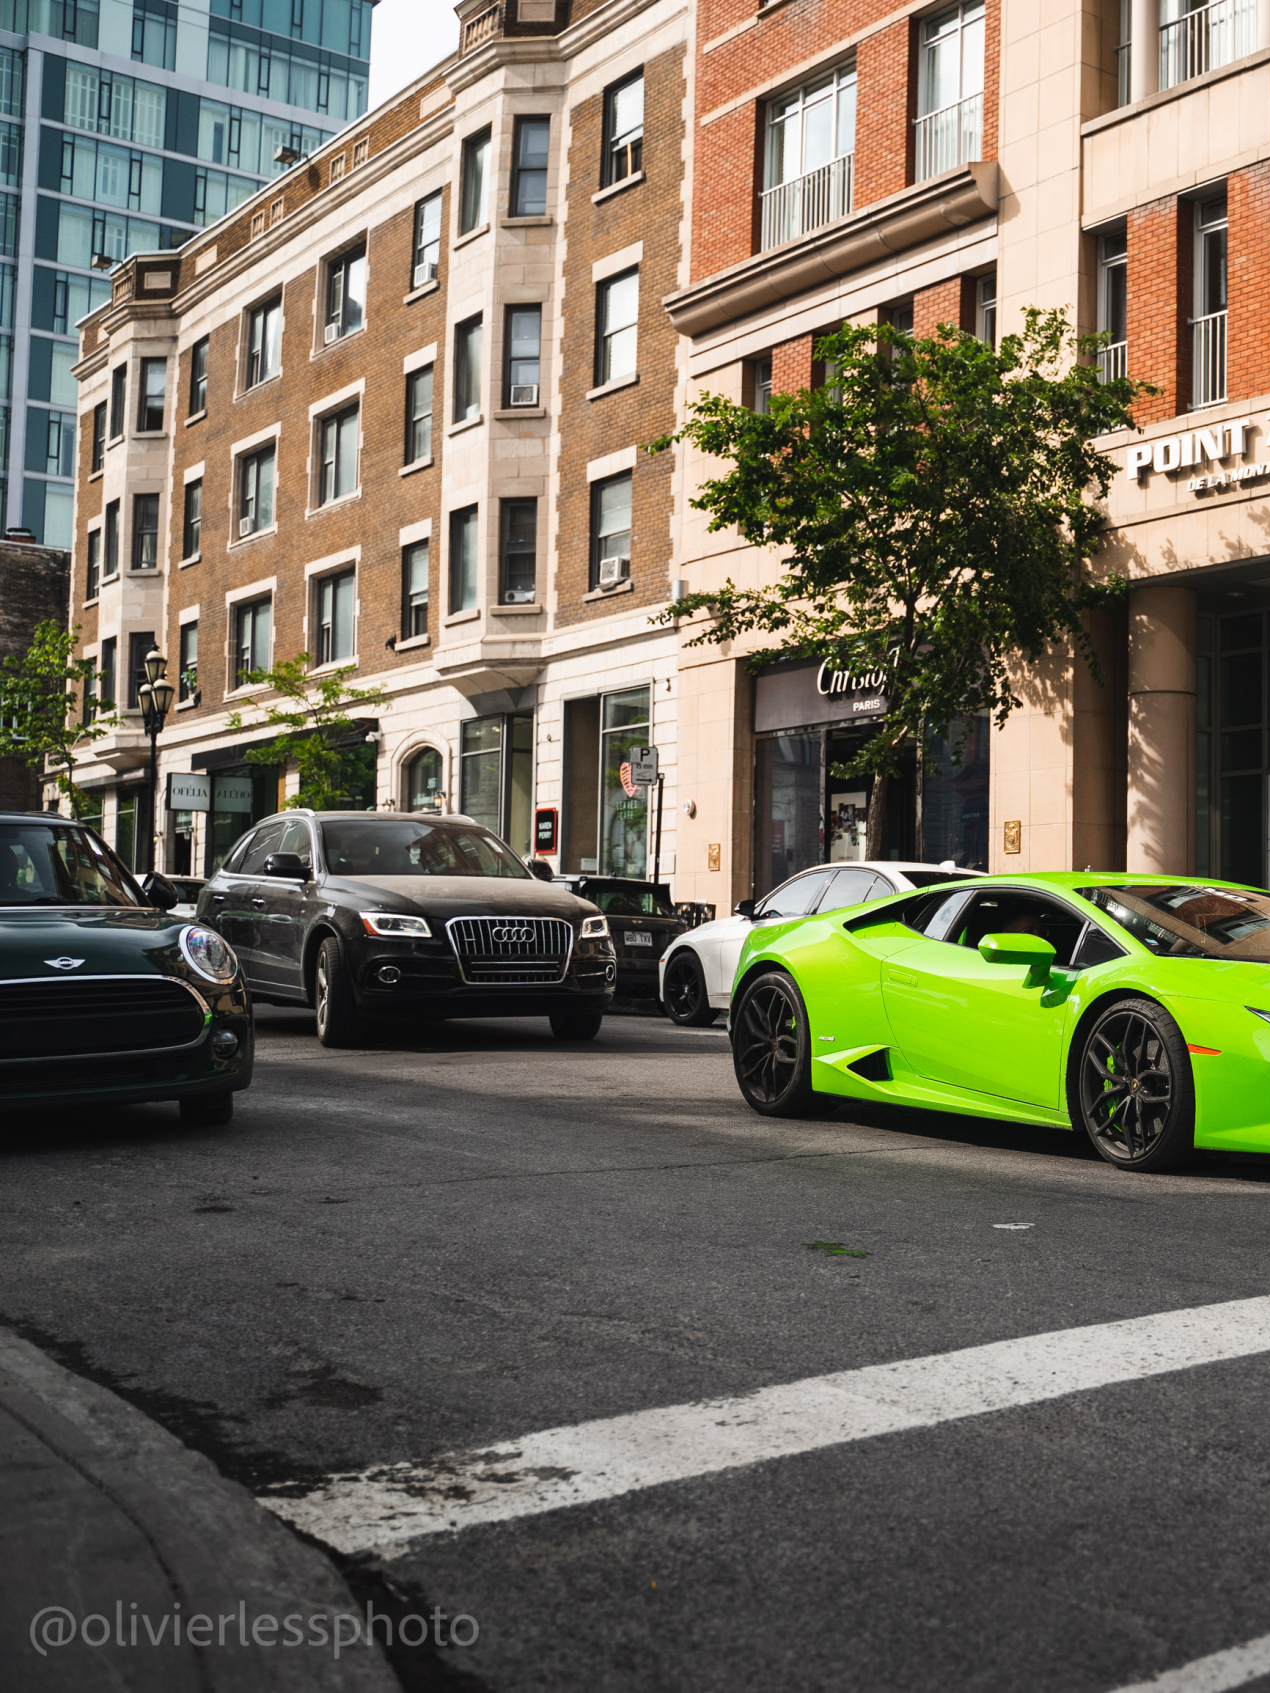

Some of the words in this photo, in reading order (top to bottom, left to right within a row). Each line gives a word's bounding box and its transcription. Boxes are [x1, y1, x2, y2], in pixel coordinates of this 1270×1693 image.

[1127, 419, 1251, 480] POINT
[1186, 478, 1207, 492] DE
[1207, 472, 1229, 488] LA
[853, 698, 880, 712] PARIS
[640, 748, 650, 762] P
[172, 785, 208, 798] OFÉLIA
[616, 799, 638, 811] LEAVES
[538, 821, 552, 831] KAREN
[538, 831, 552, 840] PERRY
